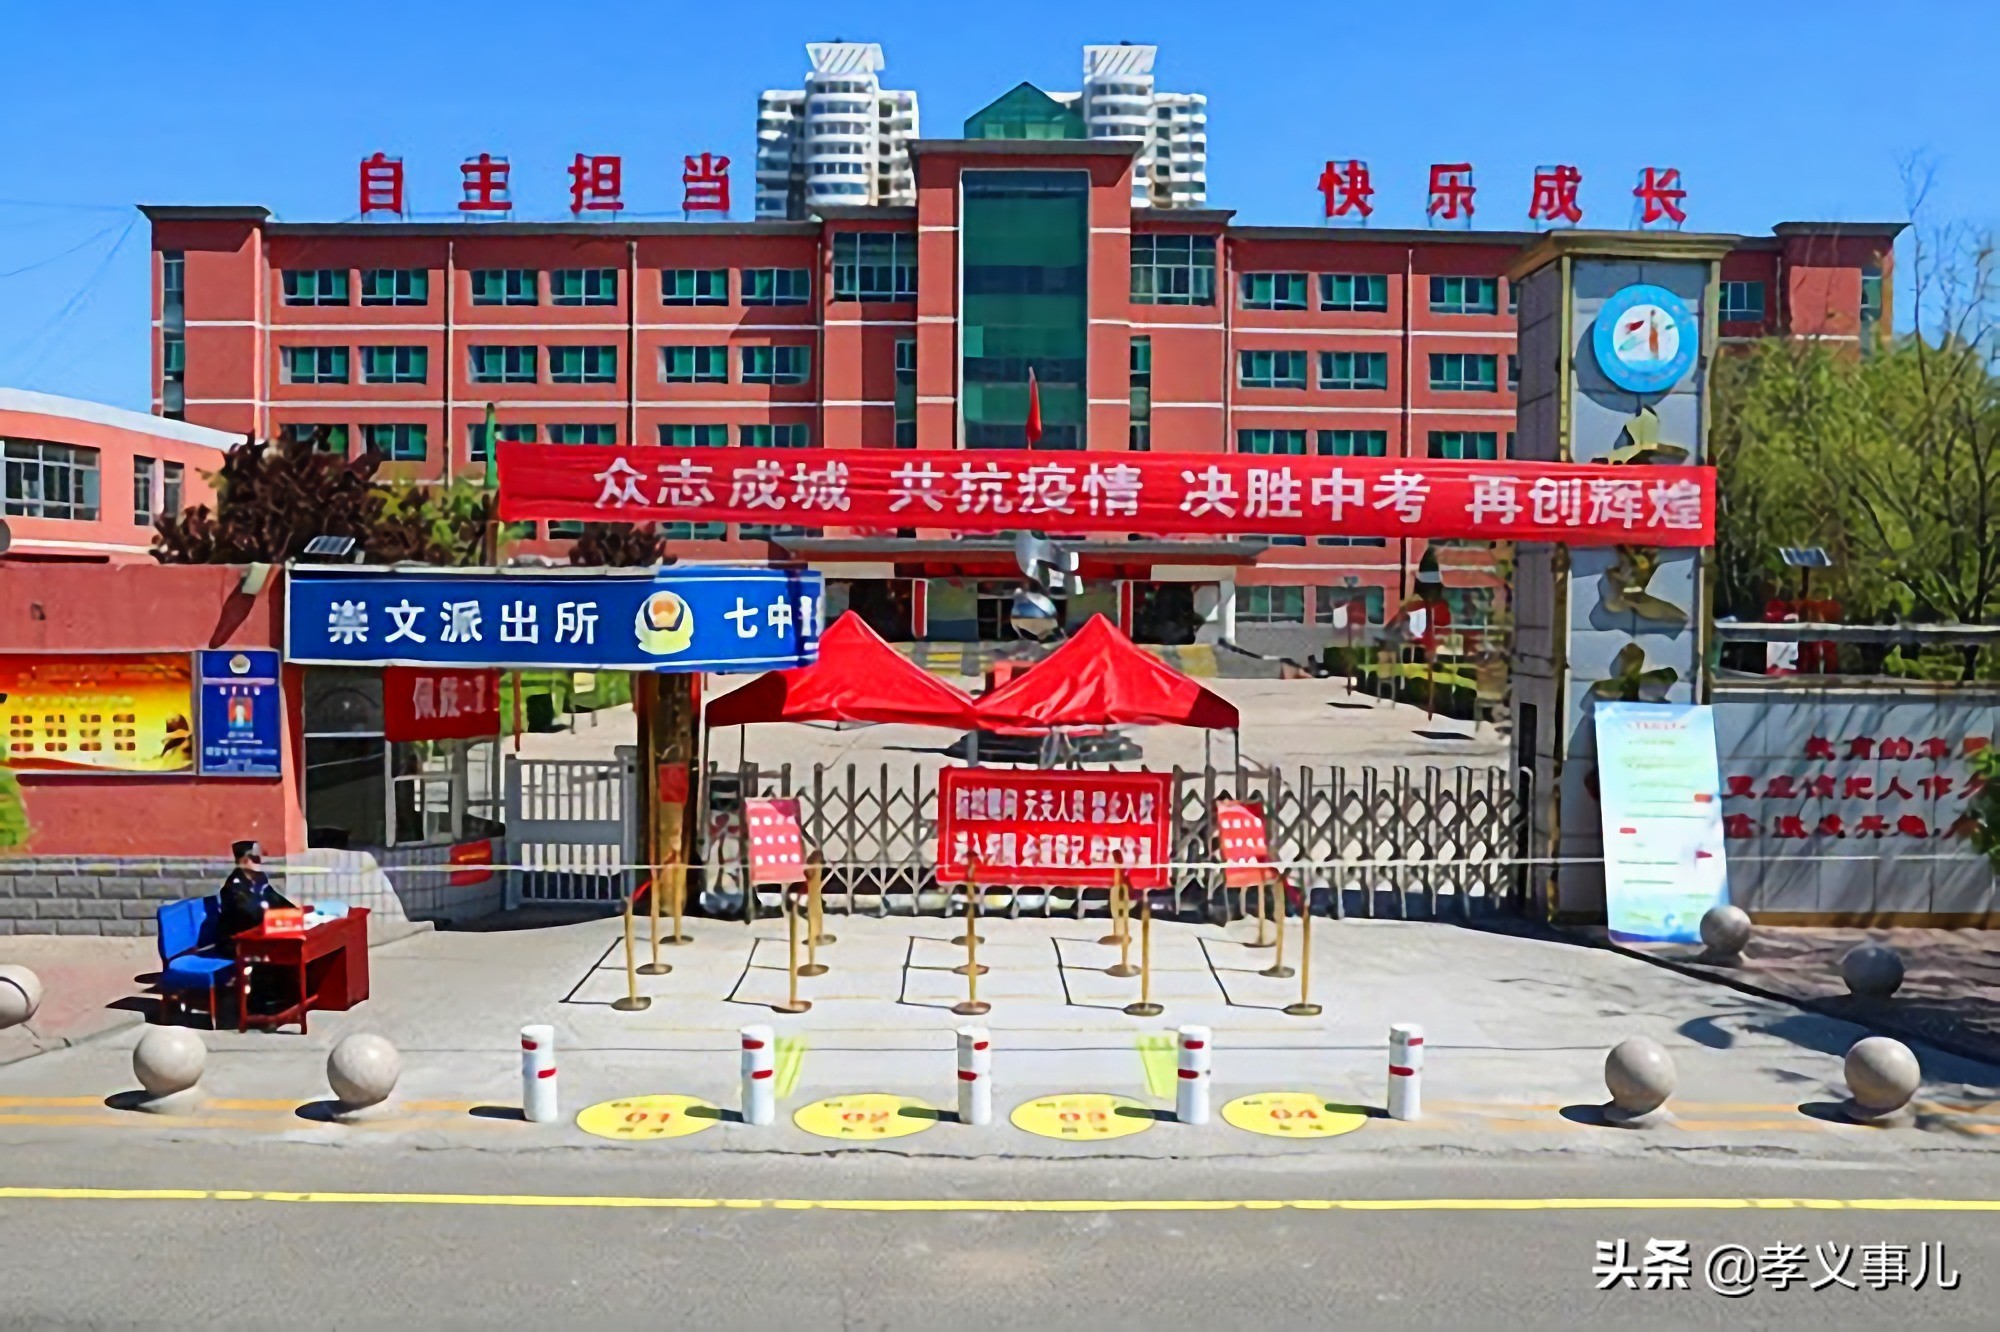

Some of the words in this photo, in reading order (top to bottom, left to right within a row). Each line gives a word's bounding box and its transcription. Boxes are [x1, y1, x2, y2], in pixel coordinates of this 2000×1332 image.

[359, 152, 731, 214] 自主担当
[1317, 159, 1688, 224] 快乐成长
[593, 457, 852, 512] 众志成城
[889, 461, 1144, 517] 共抗疫情
[1179, 465, 1431, 524] 决胜中考
[1464, 473, 1704, 531] 再创辉煌
[327, 598, 600, 645] 崇文派出所
